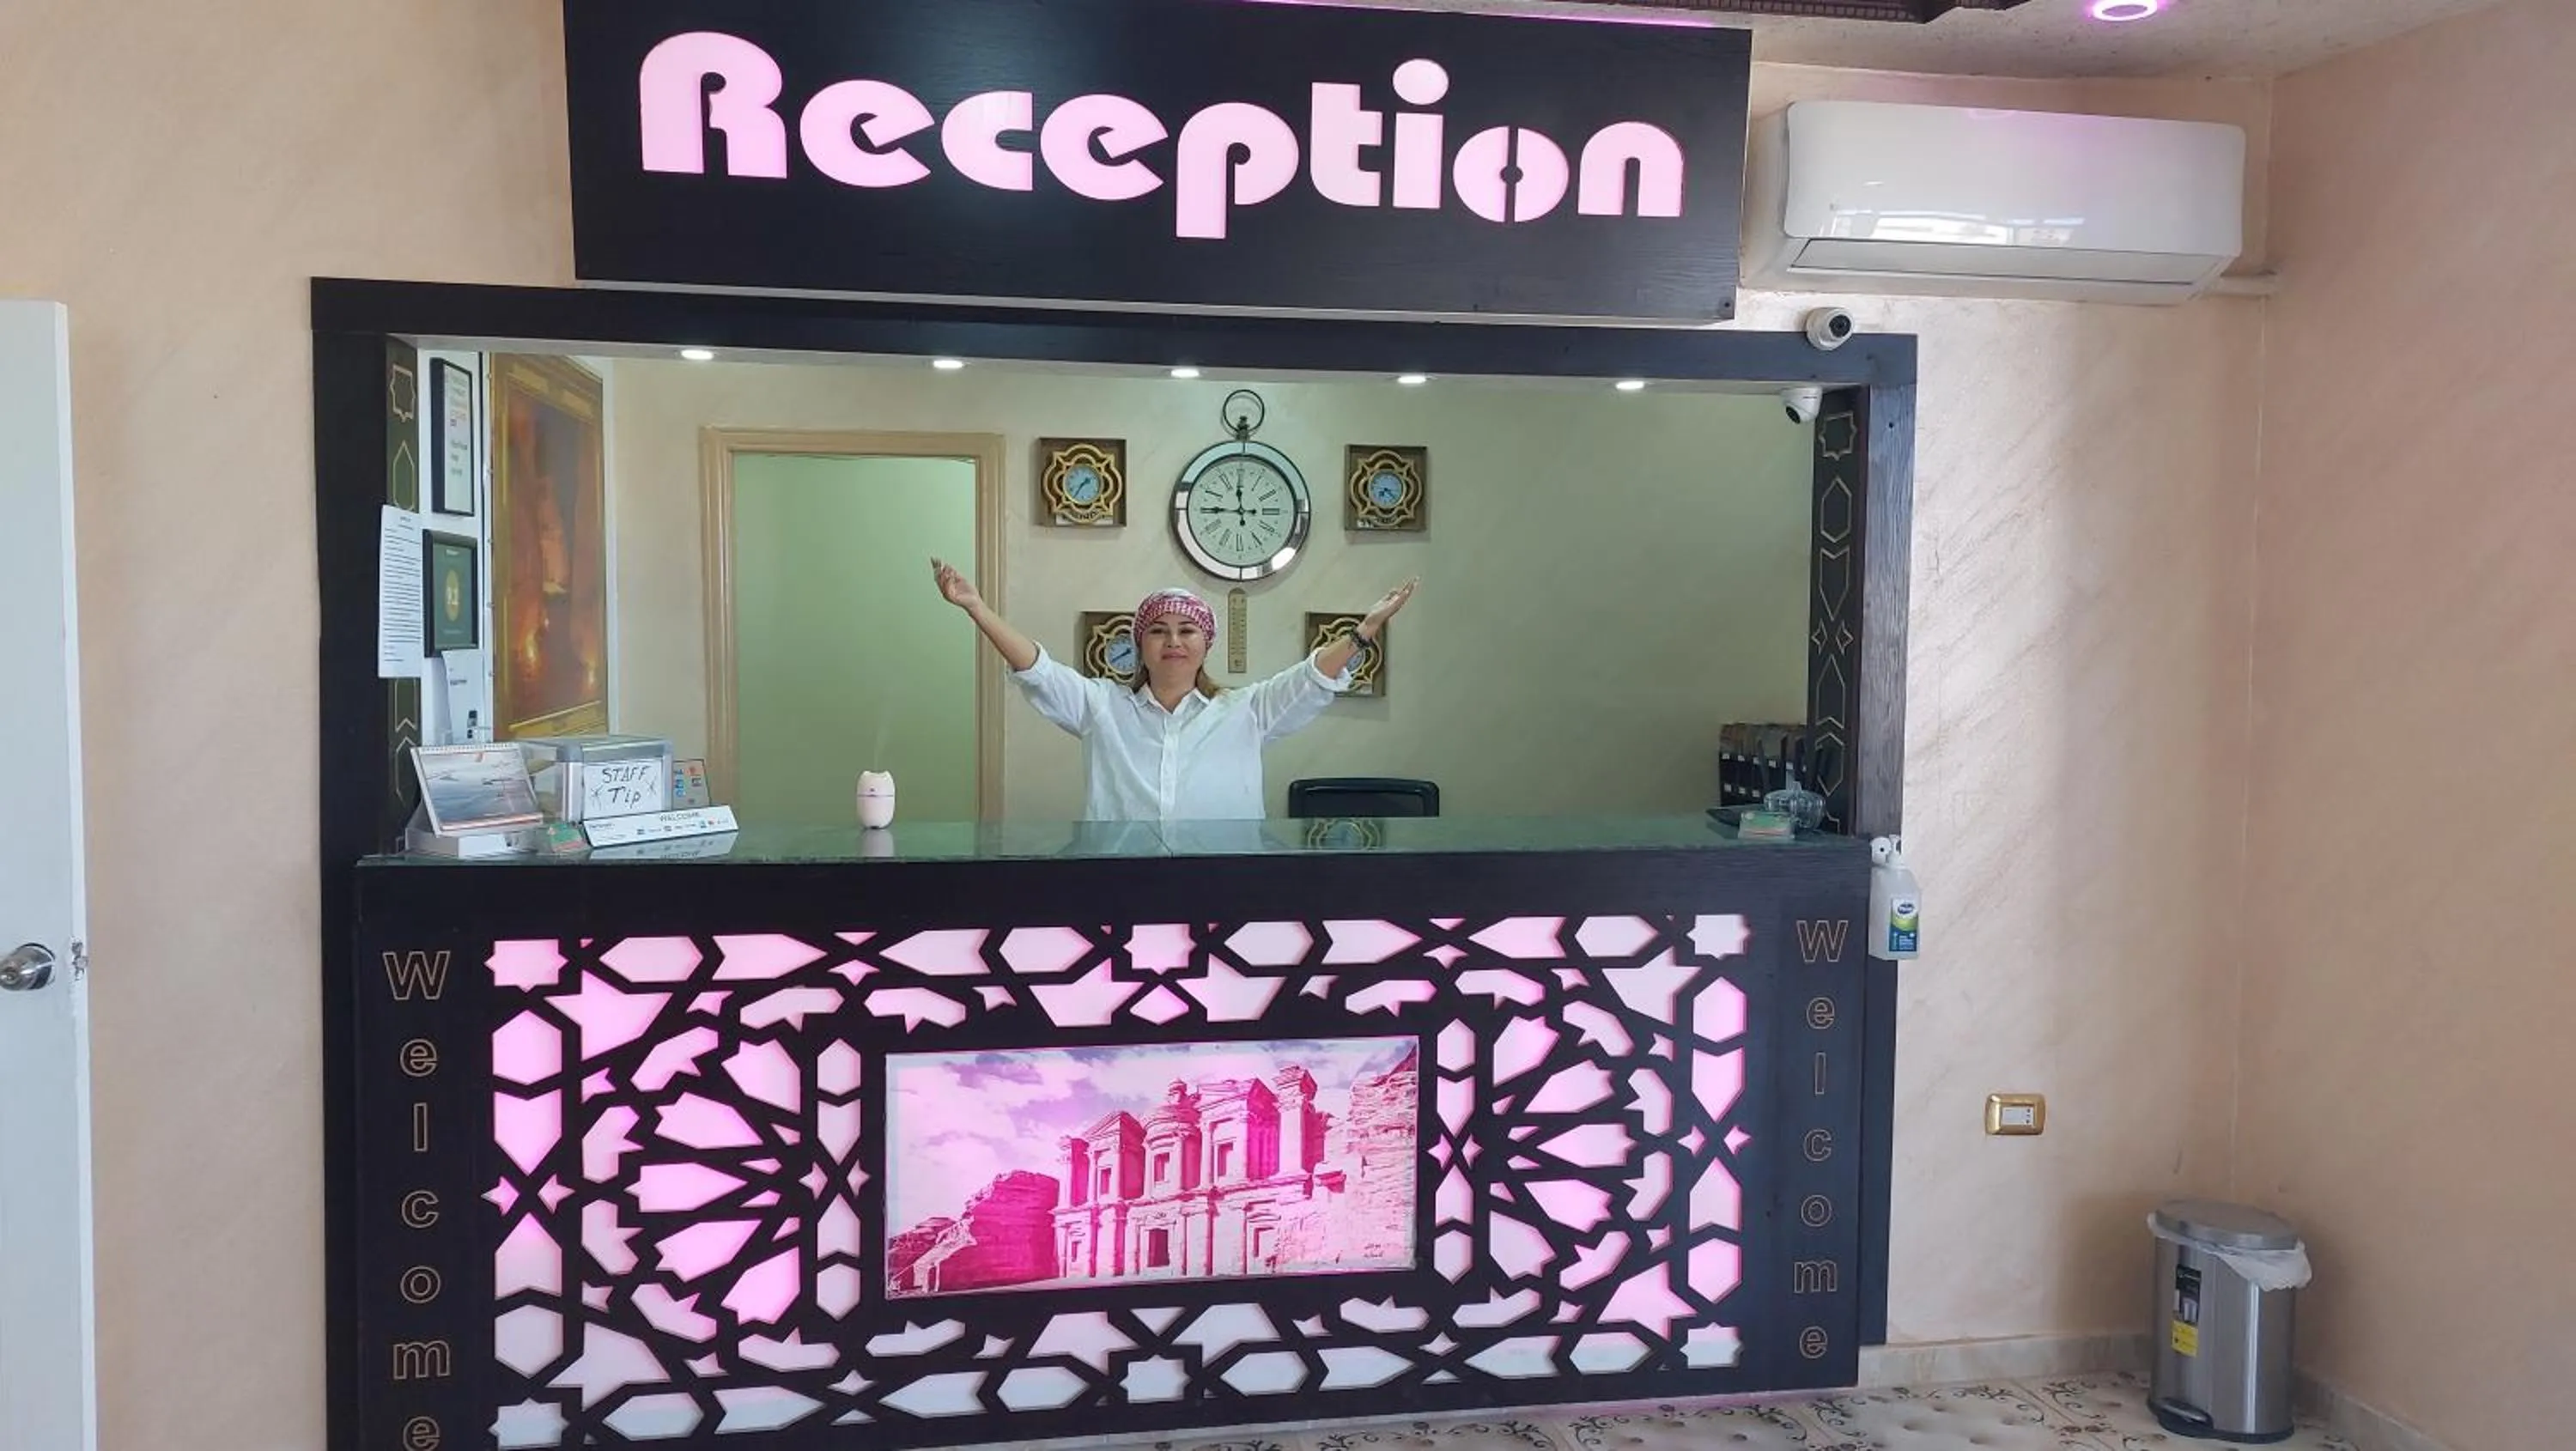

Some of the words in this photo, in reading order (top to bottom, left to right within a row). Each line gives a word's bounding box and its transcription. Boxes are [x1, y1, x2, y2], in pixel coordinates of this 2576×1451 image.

[640, 31, 1684, 240] Reception
[602, 765, 650, 784] STAFF
[608, 786, 641, 809] Tip
